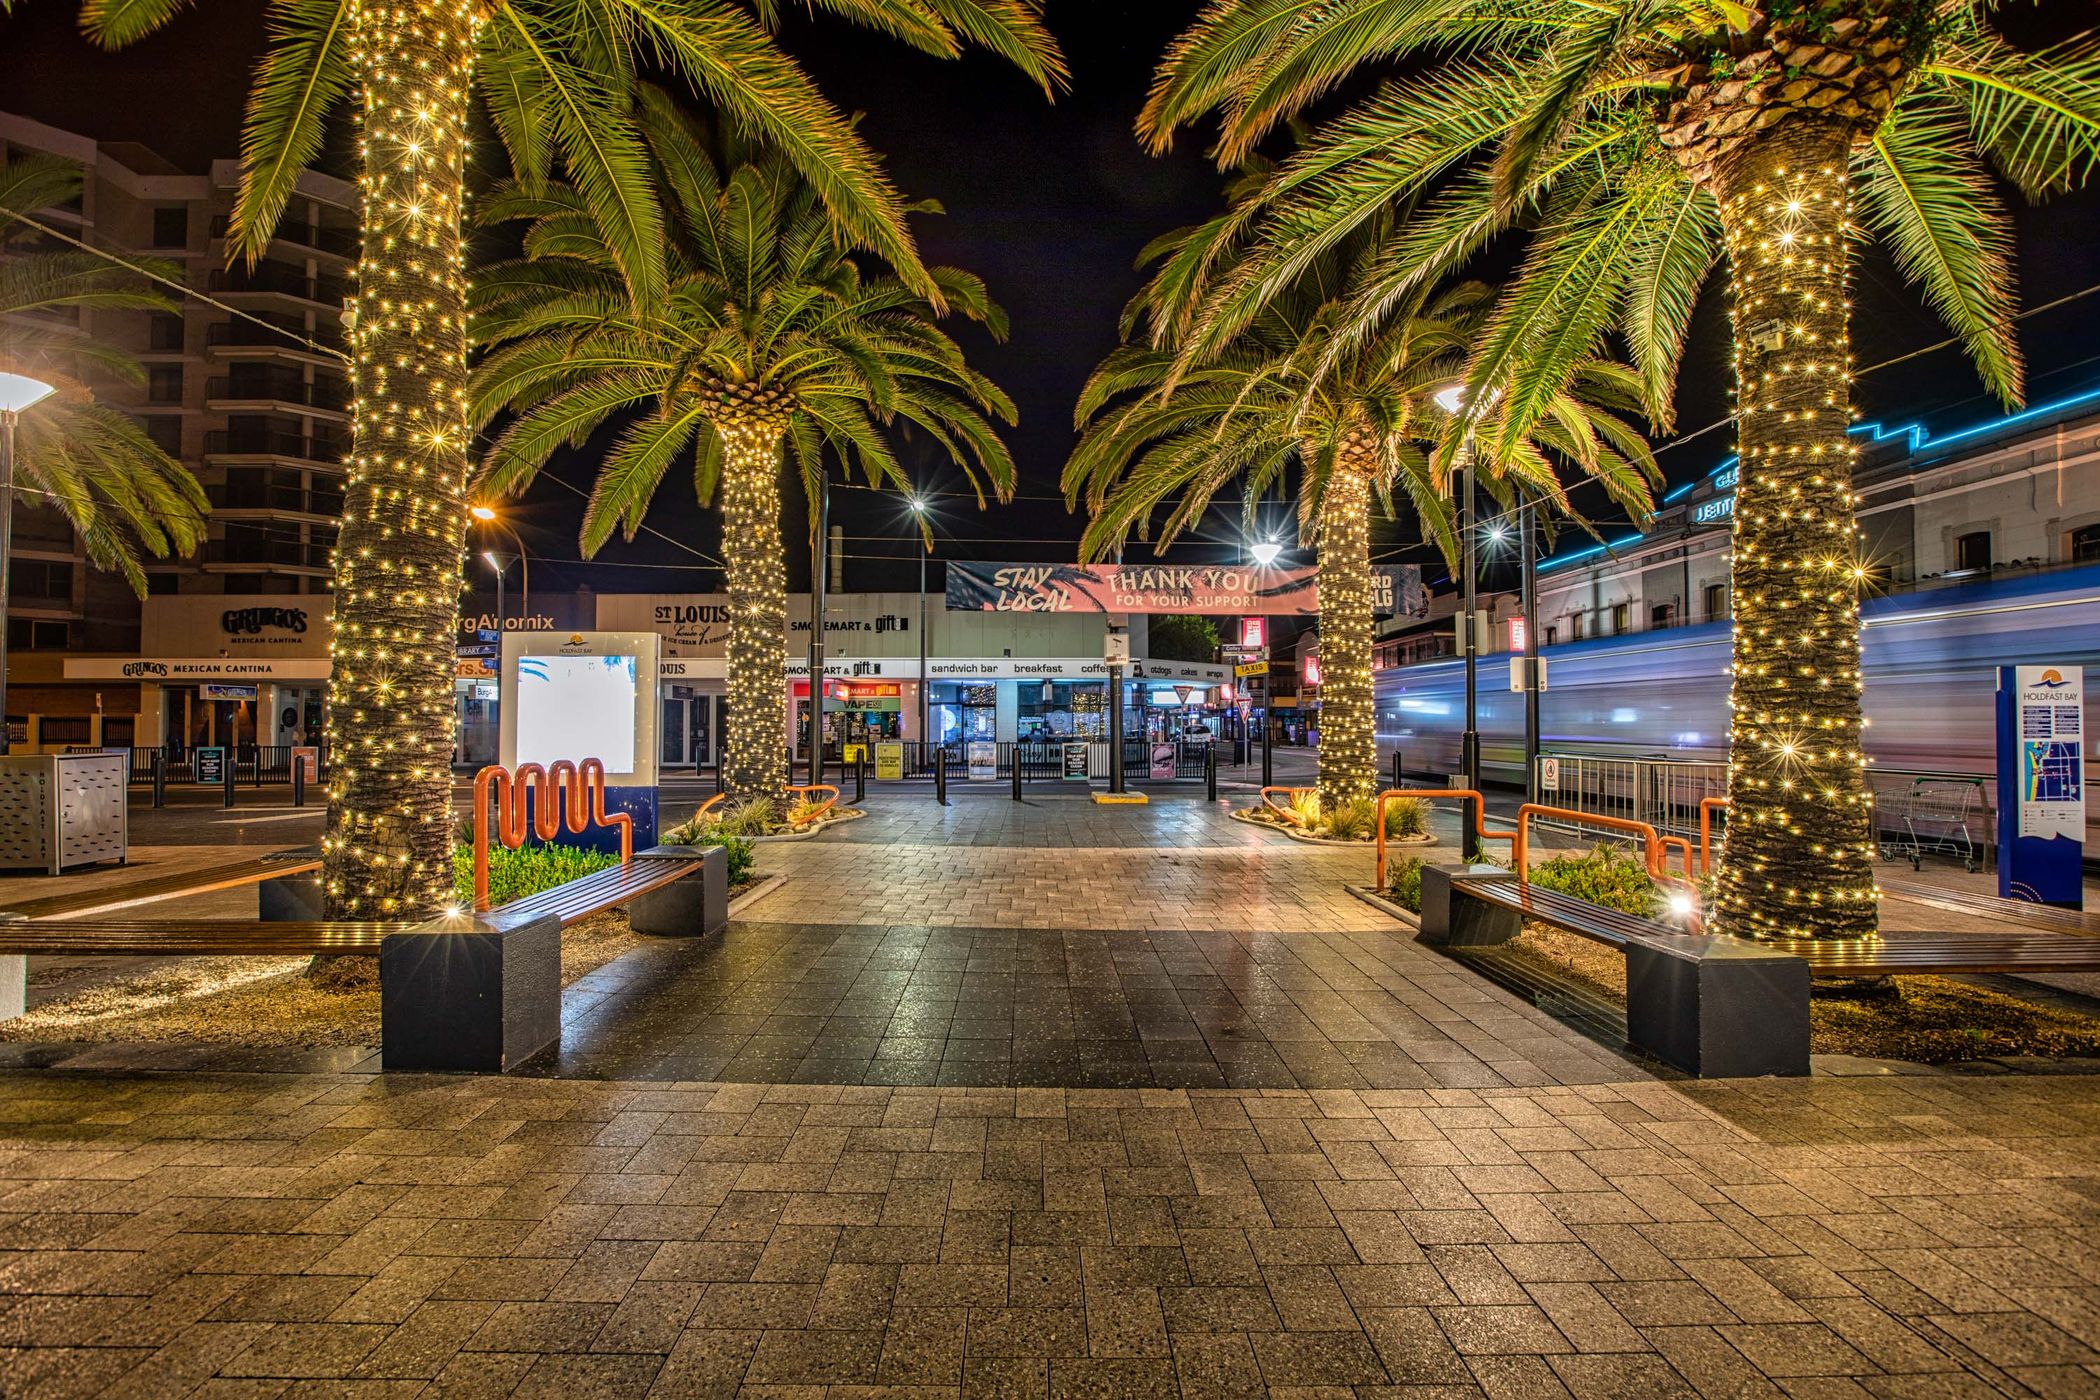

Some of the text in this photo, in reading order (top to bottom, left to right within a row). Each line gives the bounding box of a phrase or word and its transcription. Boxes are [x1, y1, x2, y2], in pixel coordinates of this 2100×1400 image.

[994, 567, 1053, 589] STAY
[1106, 570, 1259, 594] THANK YOU
[996, 589, 1073, 612] LOCAL
[1115, 595, 1258, 608] FOR YOUR SUPPORT
[655, 605, 731, 623] ST LOUIS
[863, 622, 871, 631] &
[875, 615, 896, 633] gift
[123, 662, 272, 676] GRINGO'S MEXICAN CANTINA
[931, 664, 978, 673] sandwich
[981, 664, 998, 673] bar
[1014, 664, 1063, 673] breakfast
[1180, 668, 1197, 676] cakes
[1206, 670, 1224, 679] wraps
[1240, 664, 1264, 673] TAXIS
[2023, 692, 2078, 701] HOLDFAST BAY
[844, 700, 872, 709] VAPE
